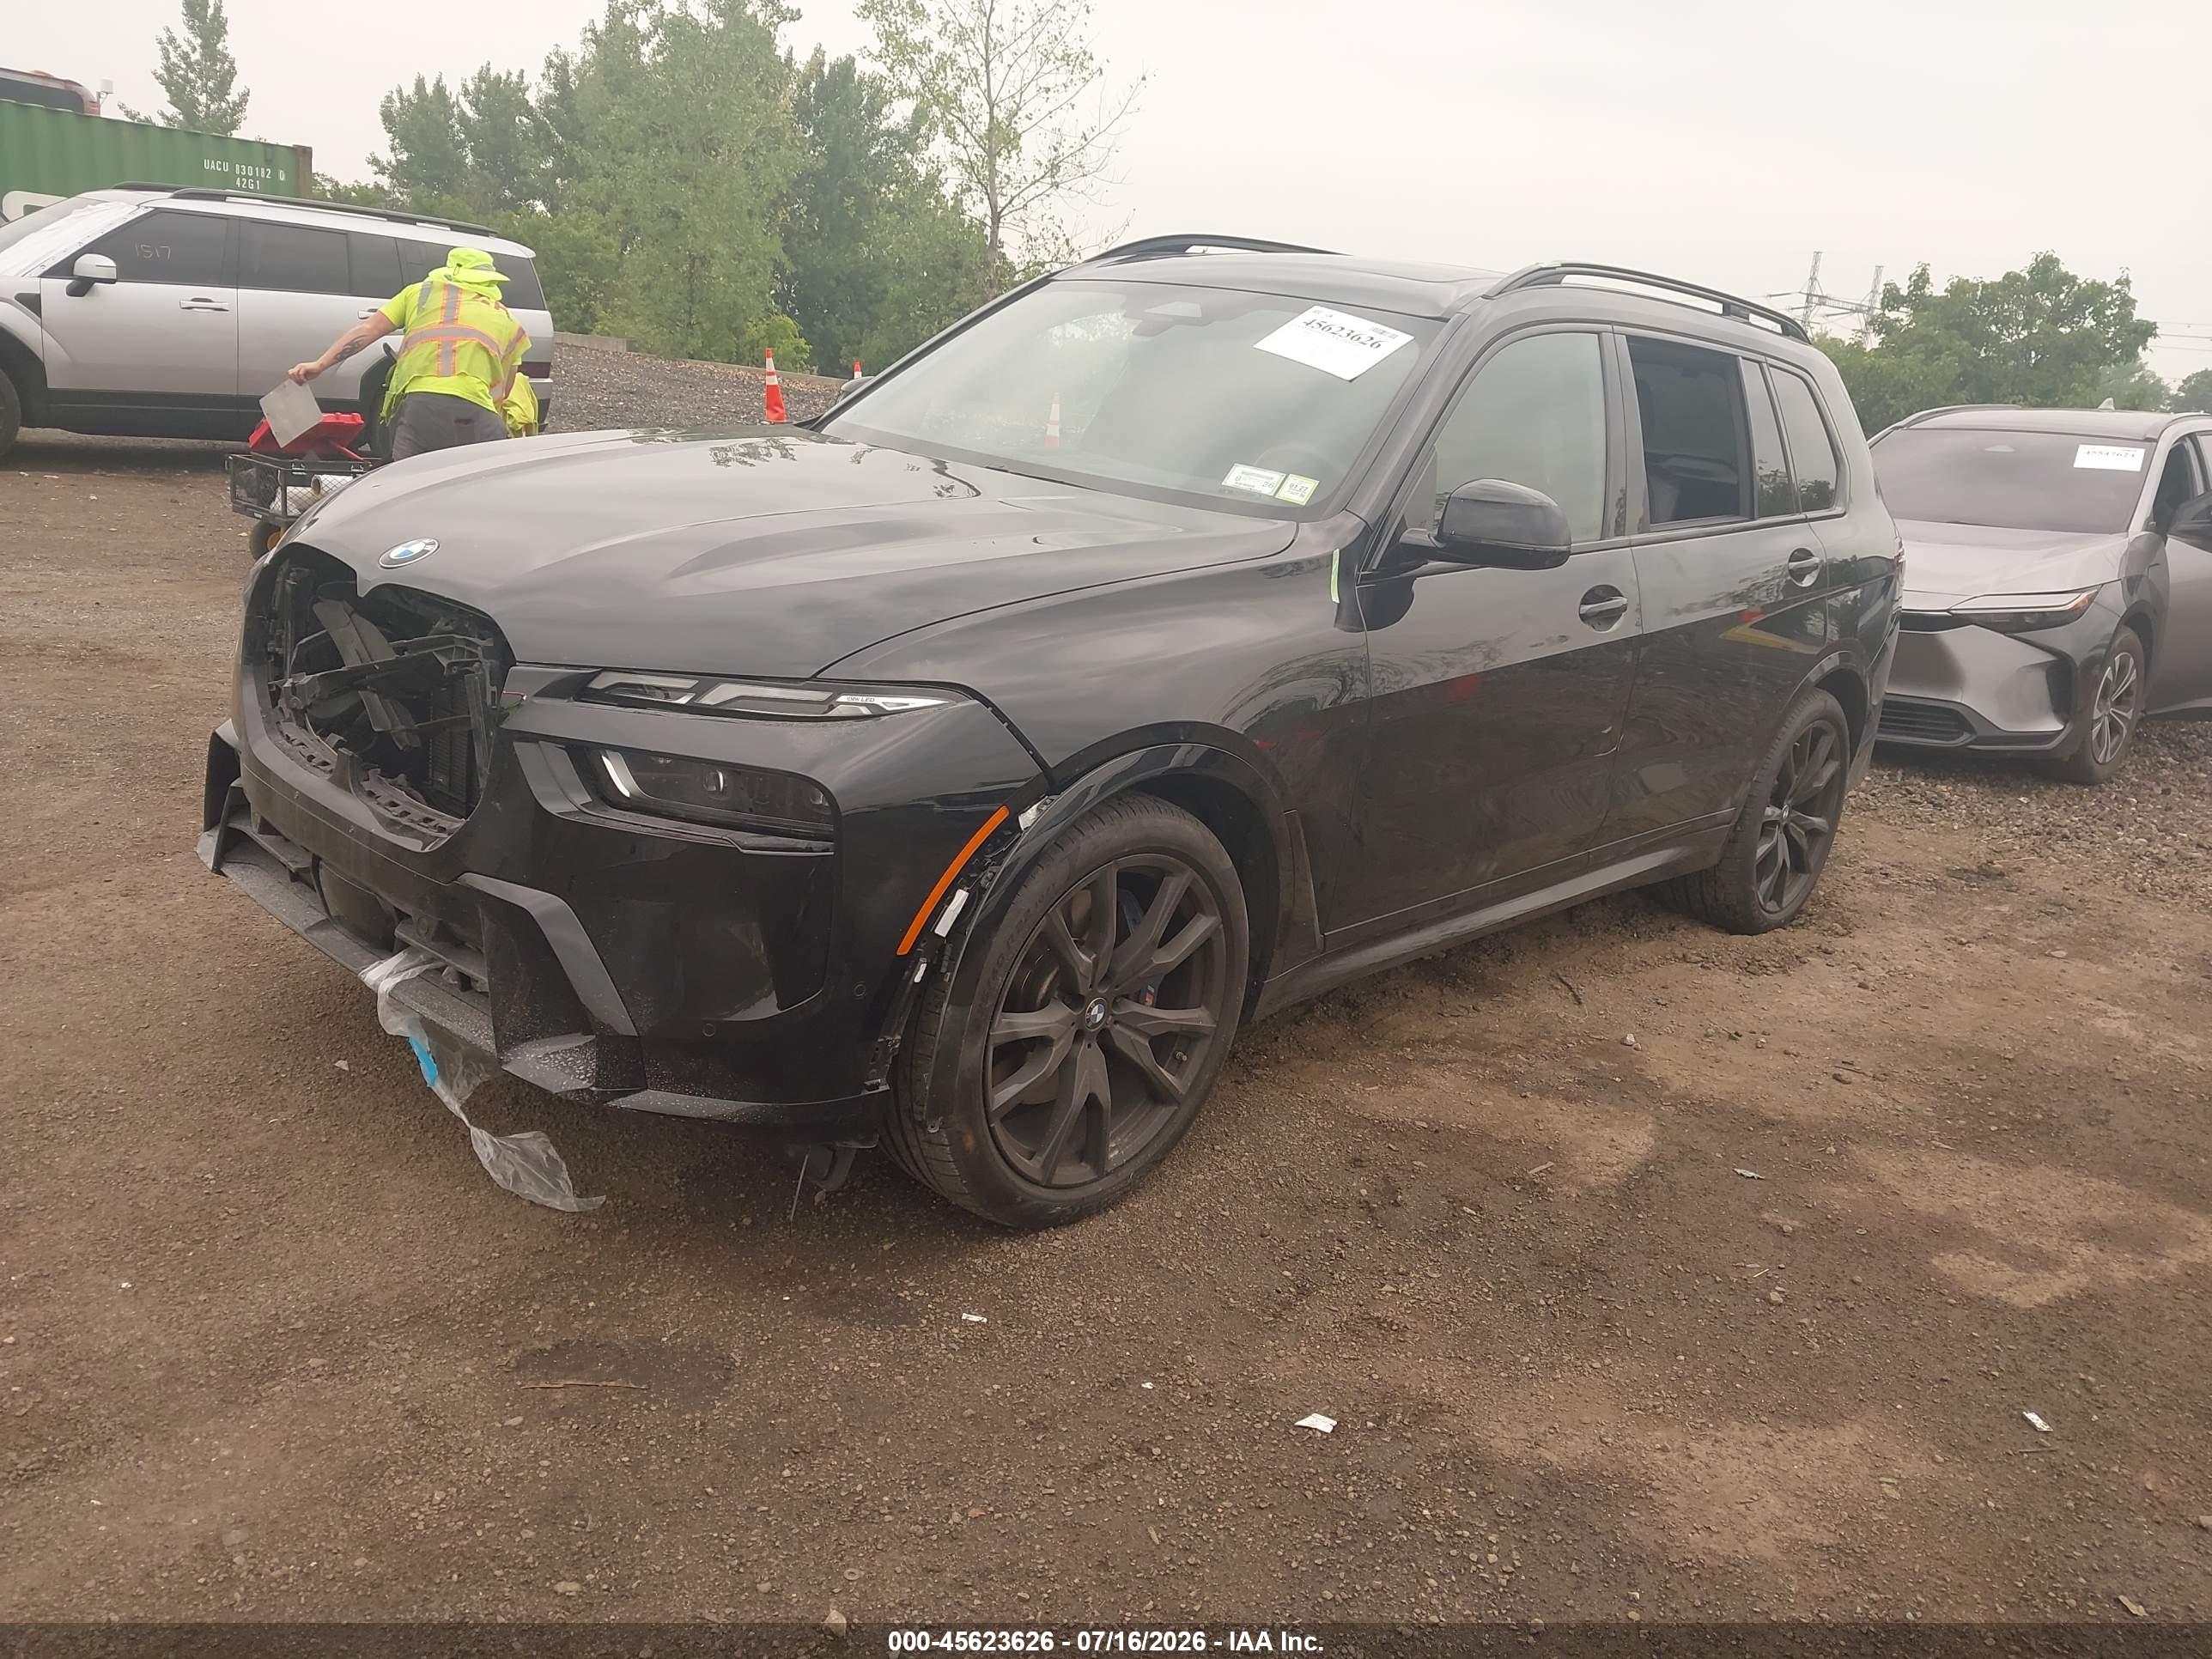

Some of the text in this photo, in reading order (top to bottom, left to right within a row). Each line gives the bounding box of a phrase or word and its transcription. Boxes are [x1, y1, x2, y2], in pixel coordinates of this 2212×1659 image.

[204, 159, 228, 172] UACU
[235, 177, 260, 190] 42G1
[1303, 319, 1385, 349] 45623626
